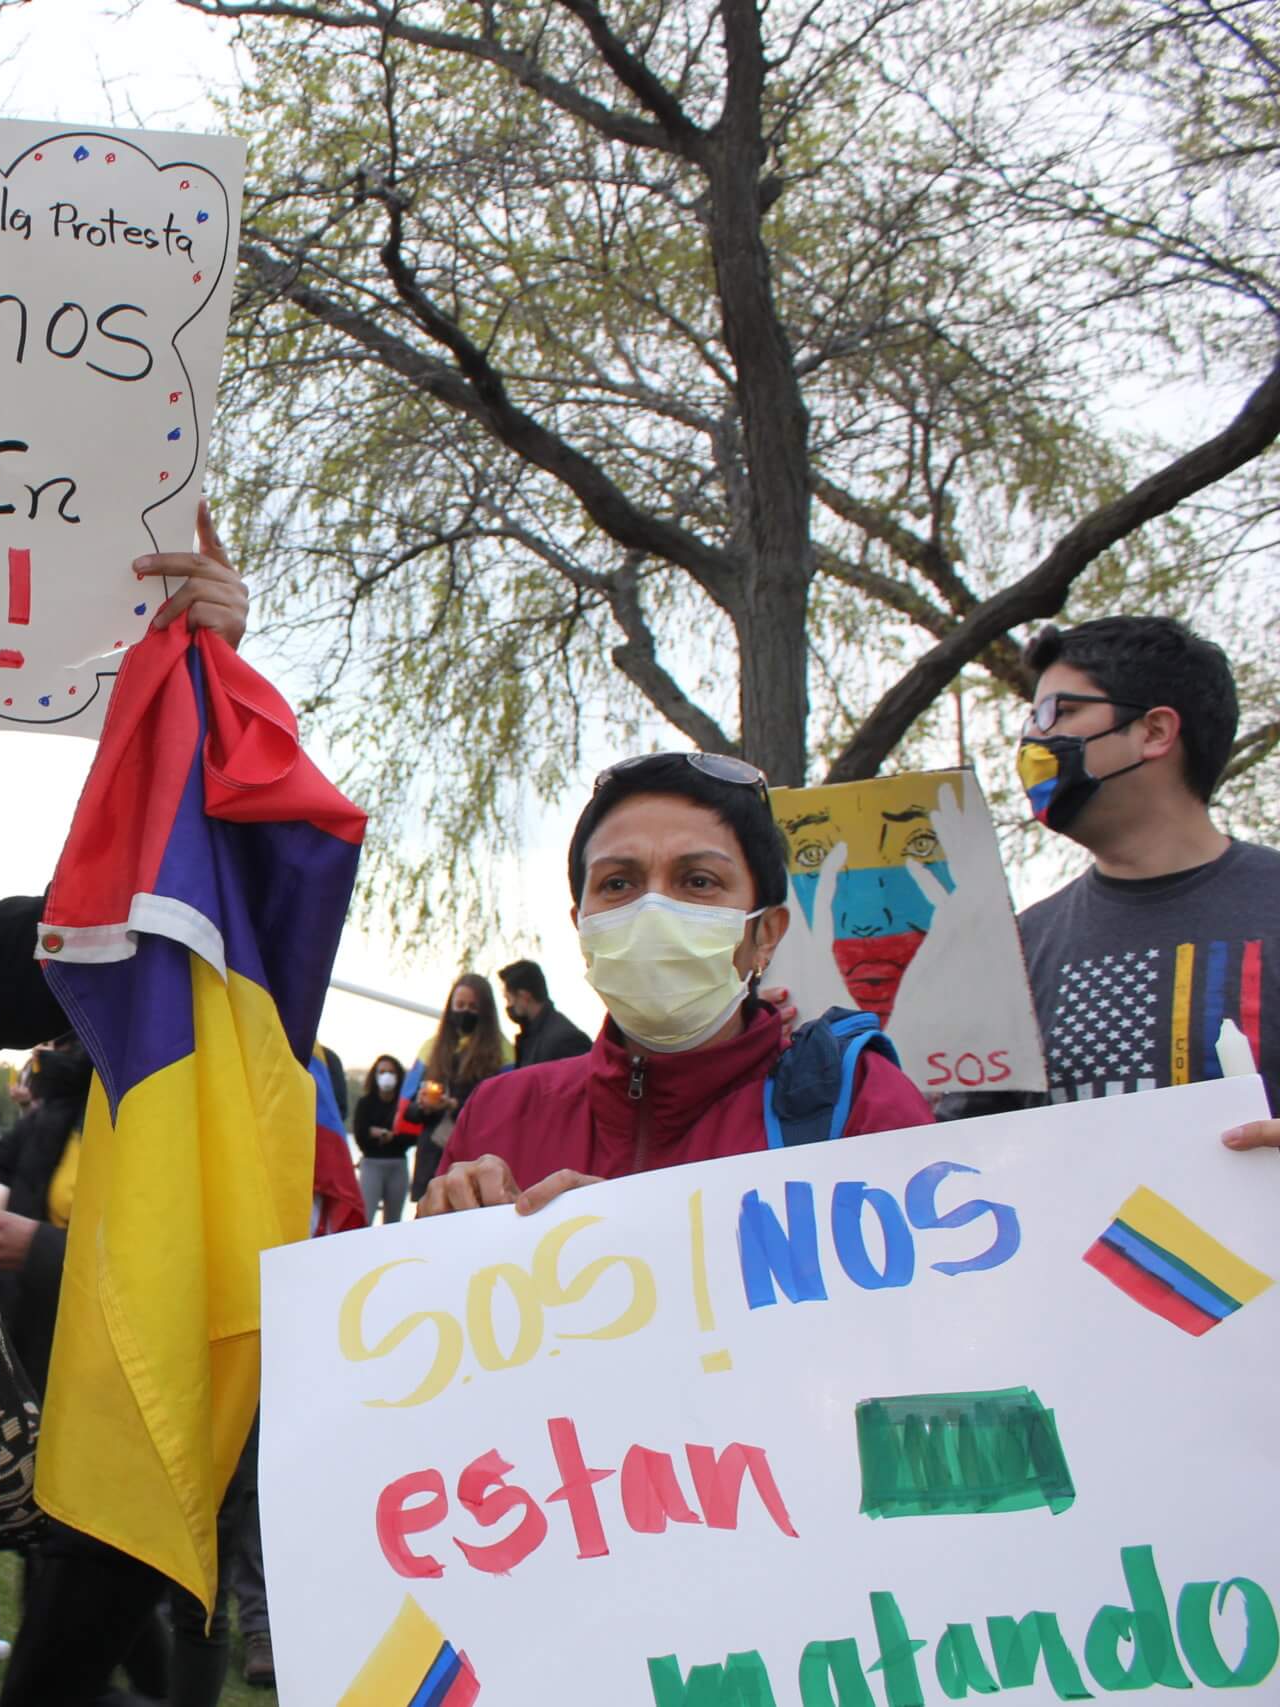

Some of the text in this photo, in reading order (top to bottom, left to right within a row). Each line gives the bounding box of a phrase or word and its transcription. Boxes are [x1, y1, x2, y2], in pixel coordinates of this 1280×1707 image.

[0, 186, 32, 241] la
[49, 202, 195, 263] Protesta
[927, 1050, 1012, 1087] SOS
[736, 1160, 1022, 1310] NOS
[375, 1416, 801, 1580] estan
[646, 1543, 1280, 1707] matando
